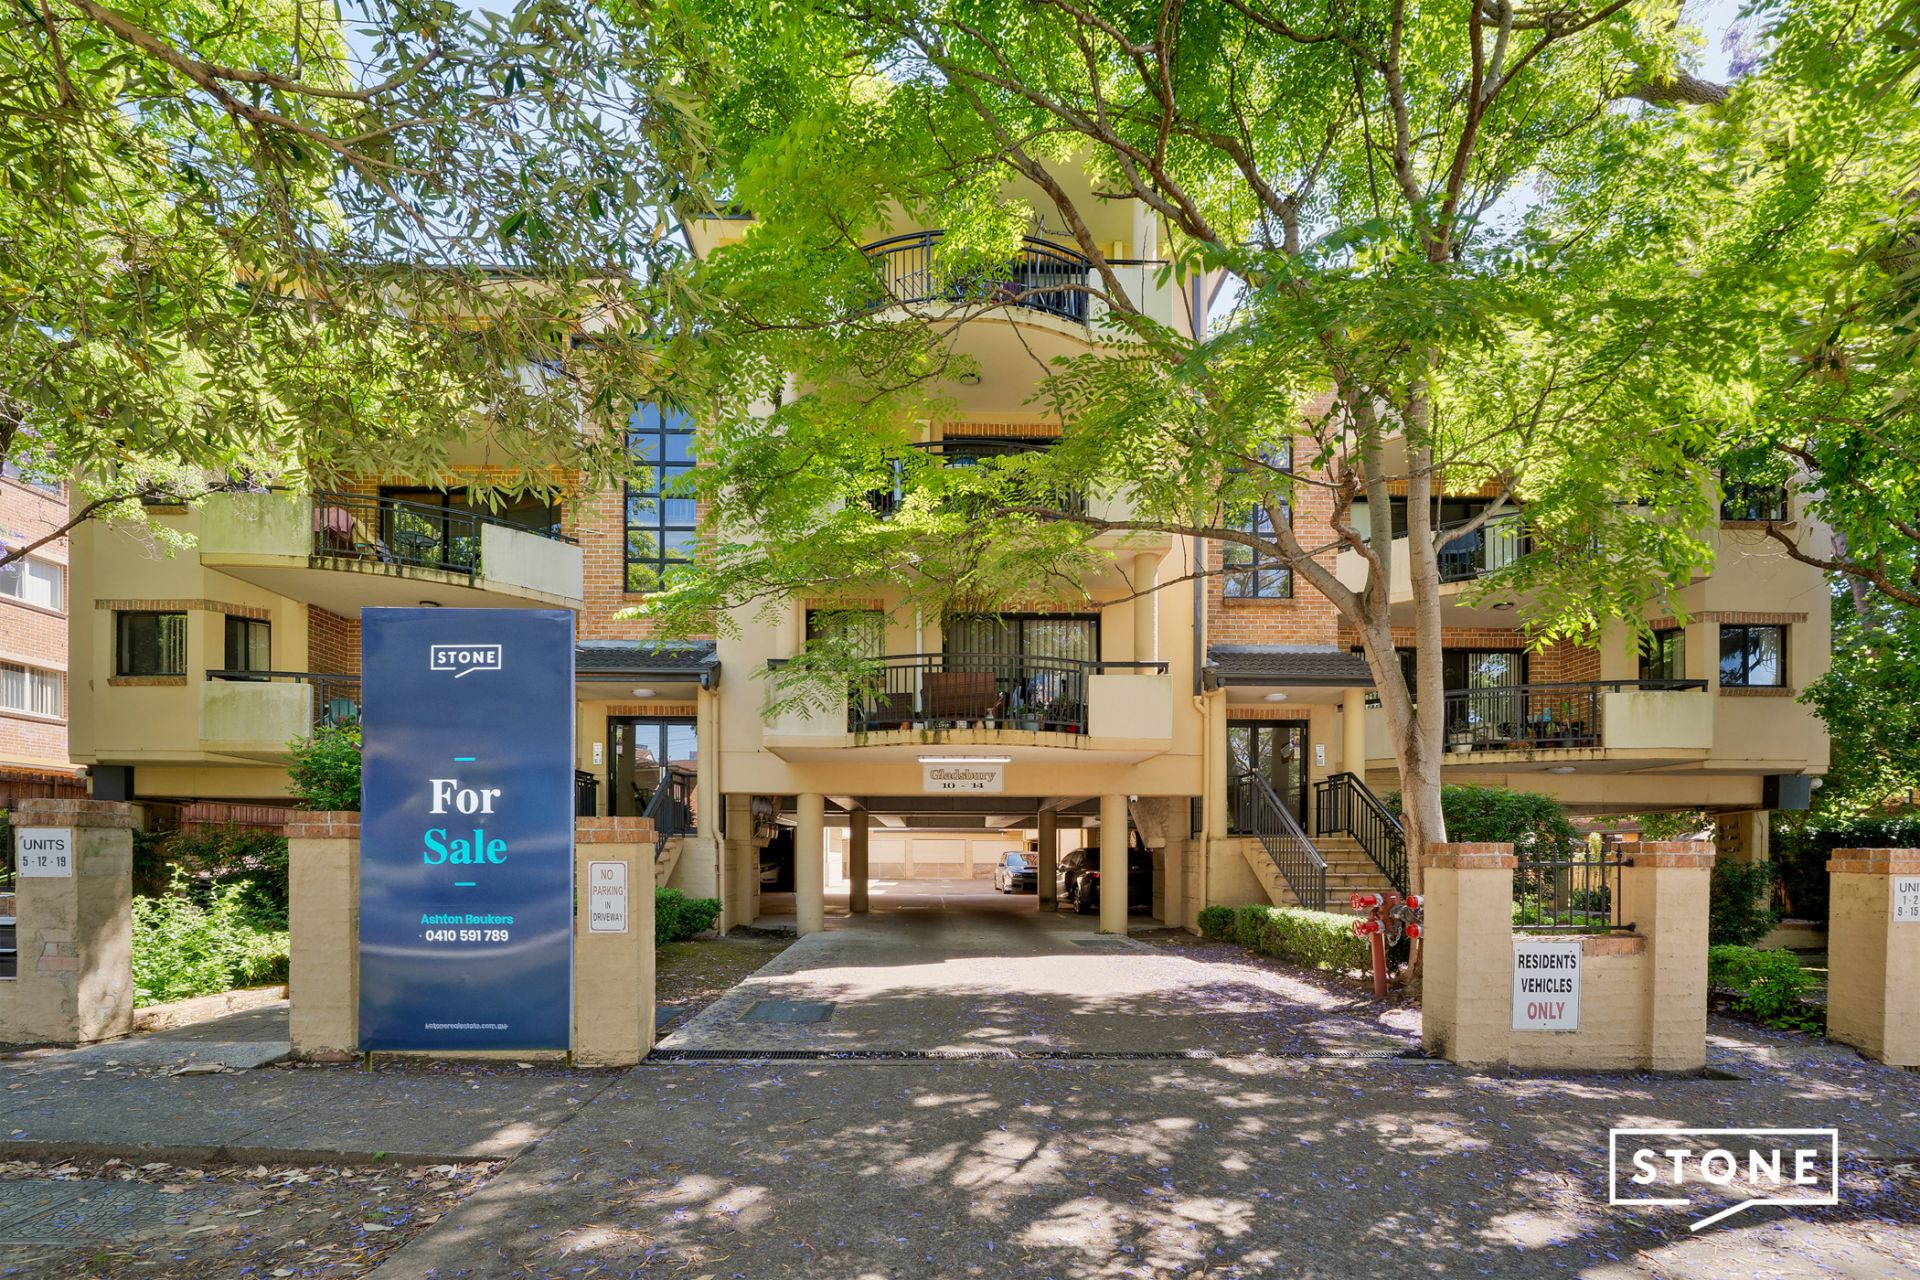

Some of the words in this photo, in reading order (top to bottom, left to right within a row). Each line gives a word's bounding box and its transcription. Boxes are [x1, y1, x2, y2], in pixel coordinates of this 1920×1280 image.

[437, 651, 496, 665] STONE
[930, 769, 996, 782] Gladsbury
[429, 780, 501, 814] For
[23, 839, 65, 850] UNITS
[423, 829, 508, 865] Sale
[23, 856, 28, 867] 5
[38, 856, 47, 867] 12
[57, 856, 66, 867] 19
[601, 870, 613, 880] NO
[593, 886, 624, 896] PARKING
[1899, 882, 1920, 893] UNI
[420, 913, 463, 925] Ashton
[465, 913, 514, 925] Beukers
[593, 913, 623, 921] DRIVEWAY
[425, 930, 456, 942] 0410
[459, 930, 481, 942] 591
[484, 930, 509, 942] 789
[1518, 954, 1577, 969] RESIDENTS
[1521, 978, 1573, 993] VEHICLES
[1527, 1002, 1566, 1020] ONLY
